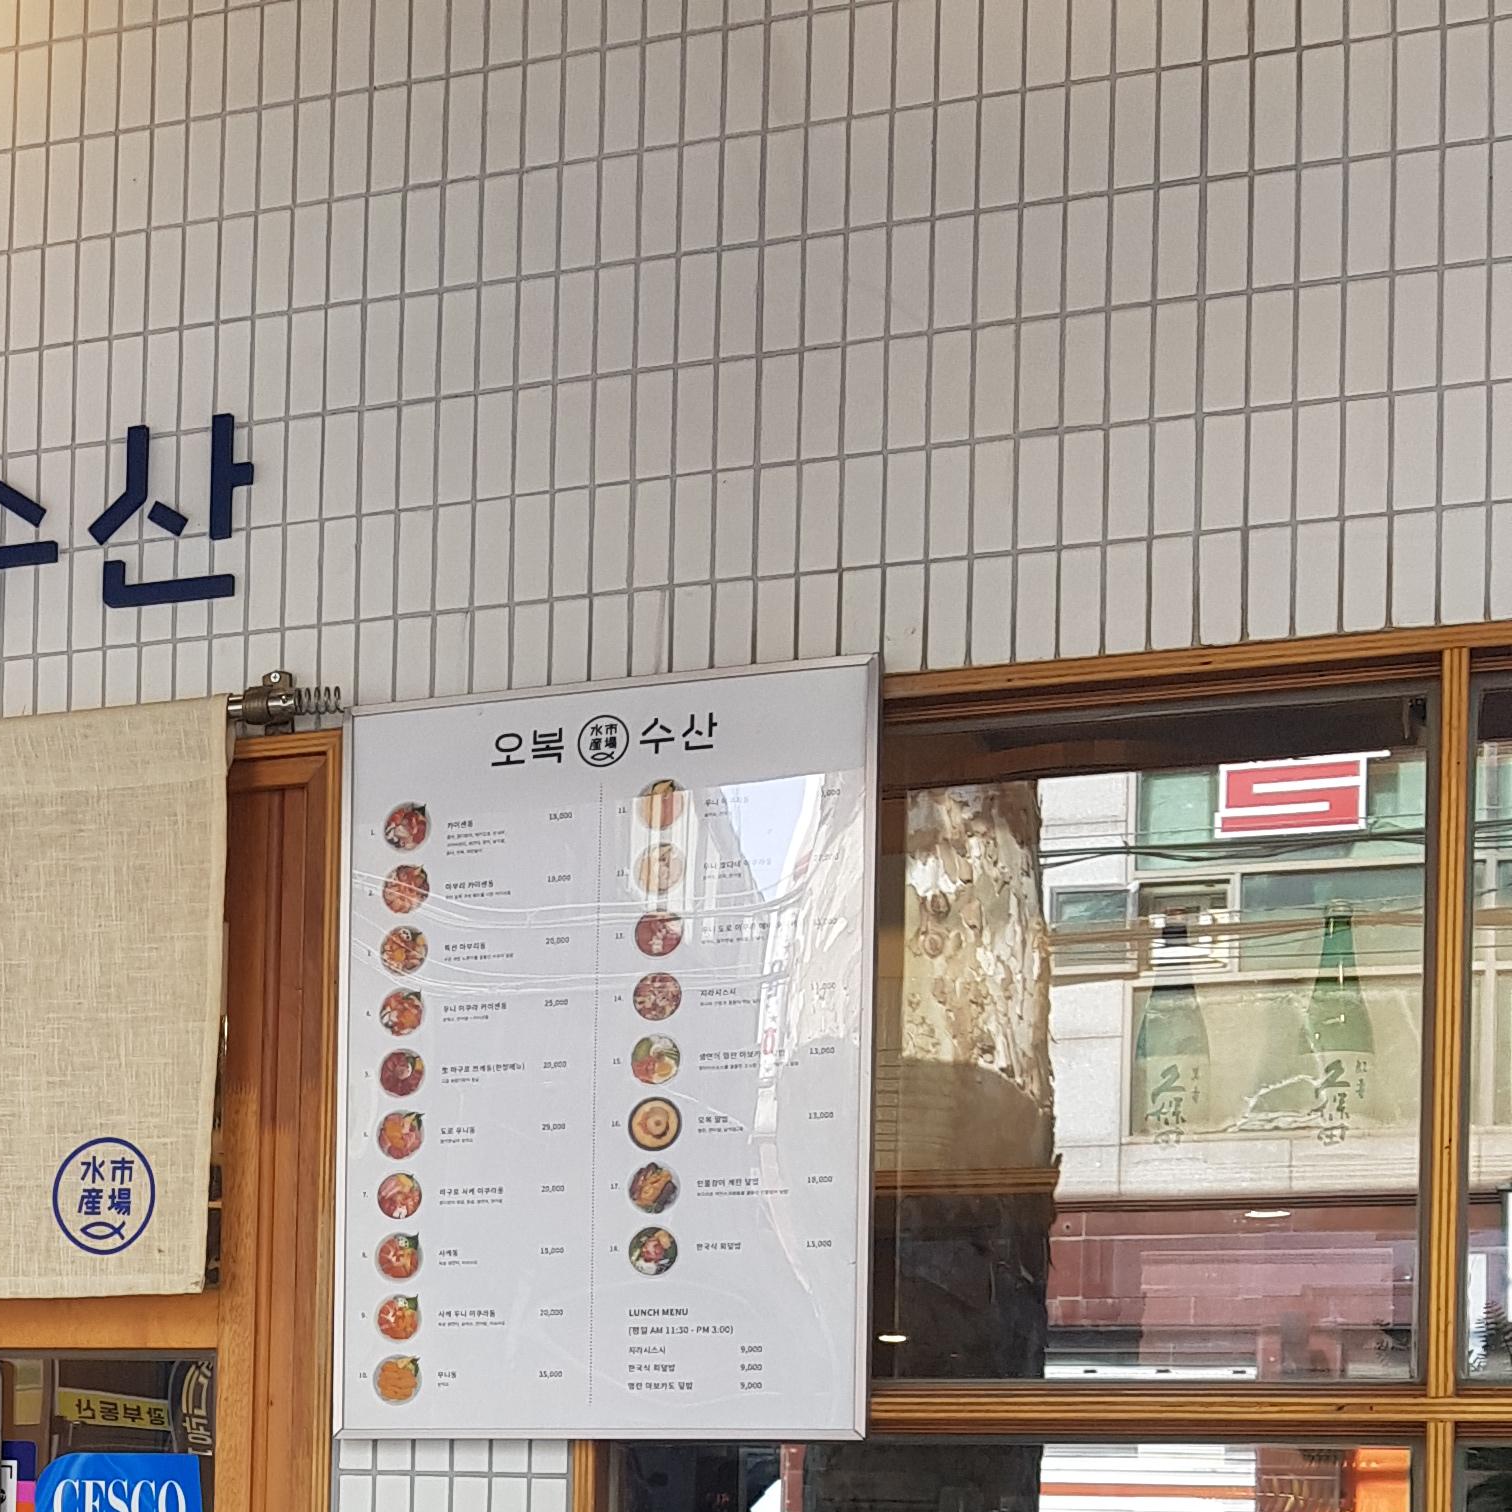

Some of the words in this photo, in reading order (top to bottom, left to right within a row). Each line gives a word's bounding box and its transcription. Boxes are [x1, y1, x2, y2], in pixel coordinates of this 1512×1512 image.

[639, 712, 718, 755] 수산
[491, 727, 565, 767] 오복
[628, 1308, 660, 1317] LUNCH
[662, 1308, 689, 1316] MENU
[649, 1326, 663, 1335] AM
[696, 1325, 710, 1334] PM
[740, 1345, 763, 1354] 9,000
[740, 1363, 763, 1372] 9,000
